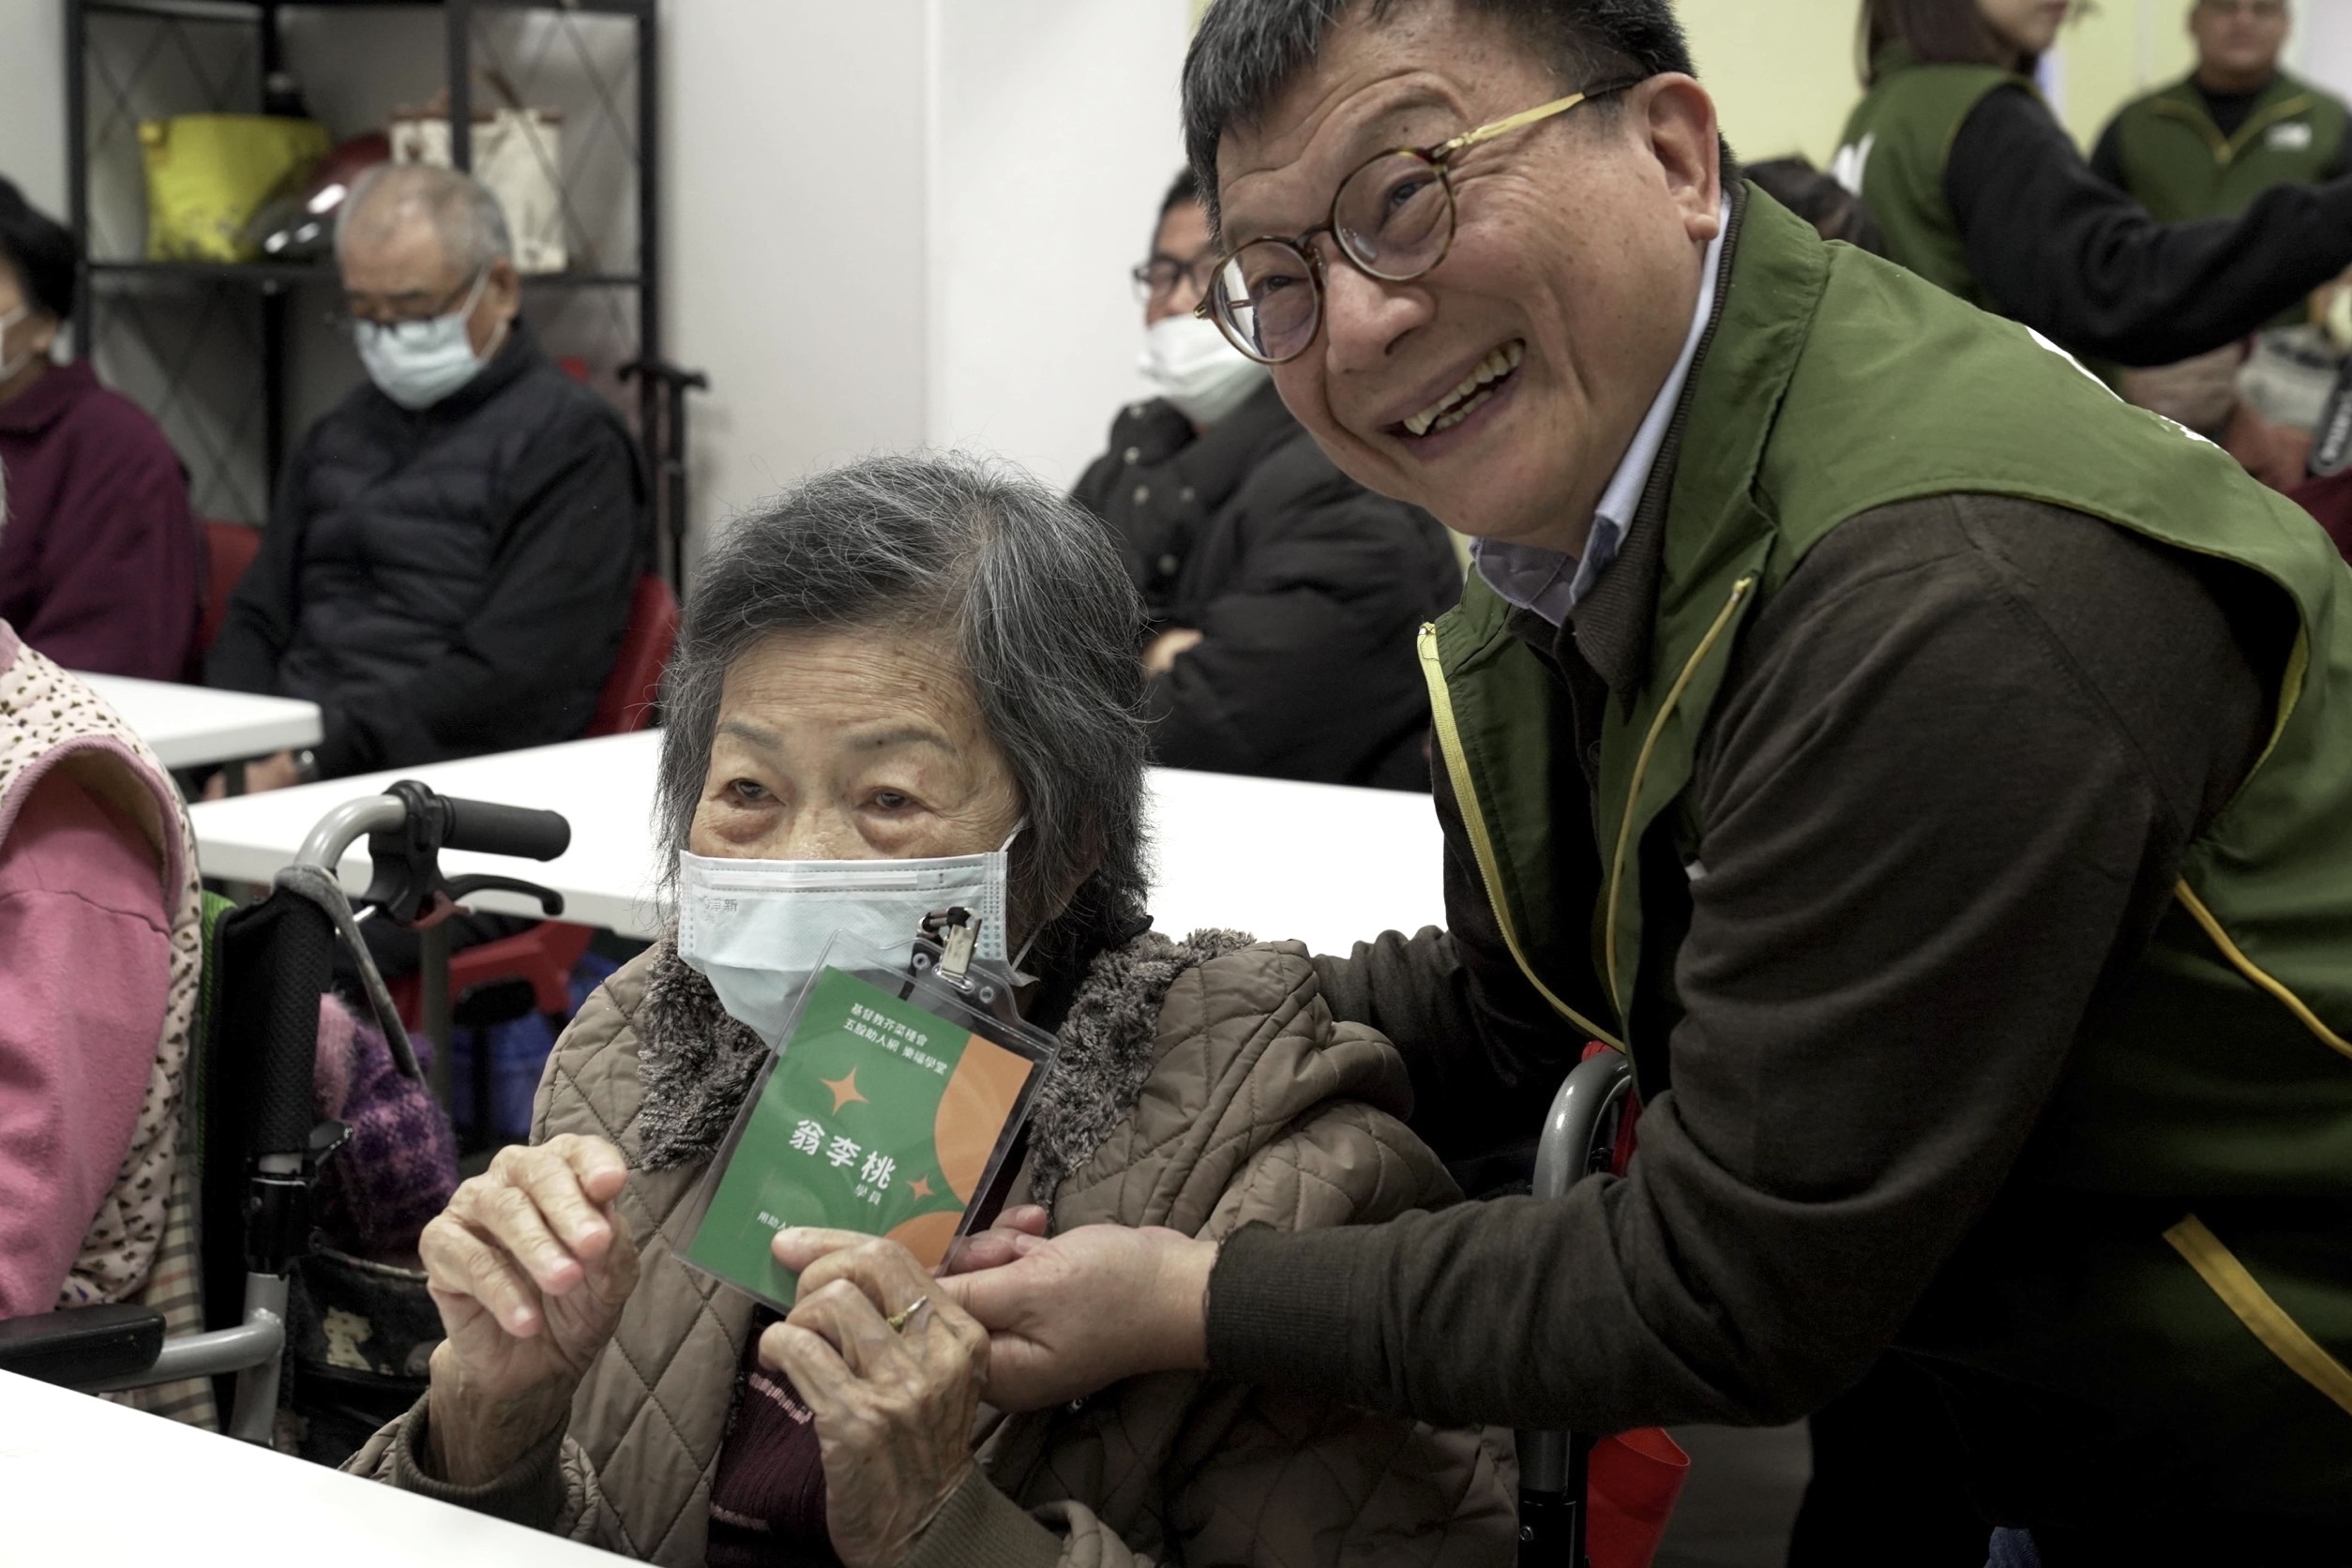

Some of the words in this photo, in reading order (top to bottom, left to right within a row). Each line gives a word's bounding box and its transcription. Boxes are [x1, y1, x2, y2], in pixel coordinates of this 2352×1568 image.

[843, 1018, 900, 1052] 五股助人網
[851, 1003, 927, 1047] 基督教芥菜種會
[789, 1120, 896, 1189] 翁李桃
[854, 1184, 882, 1205] 學員
